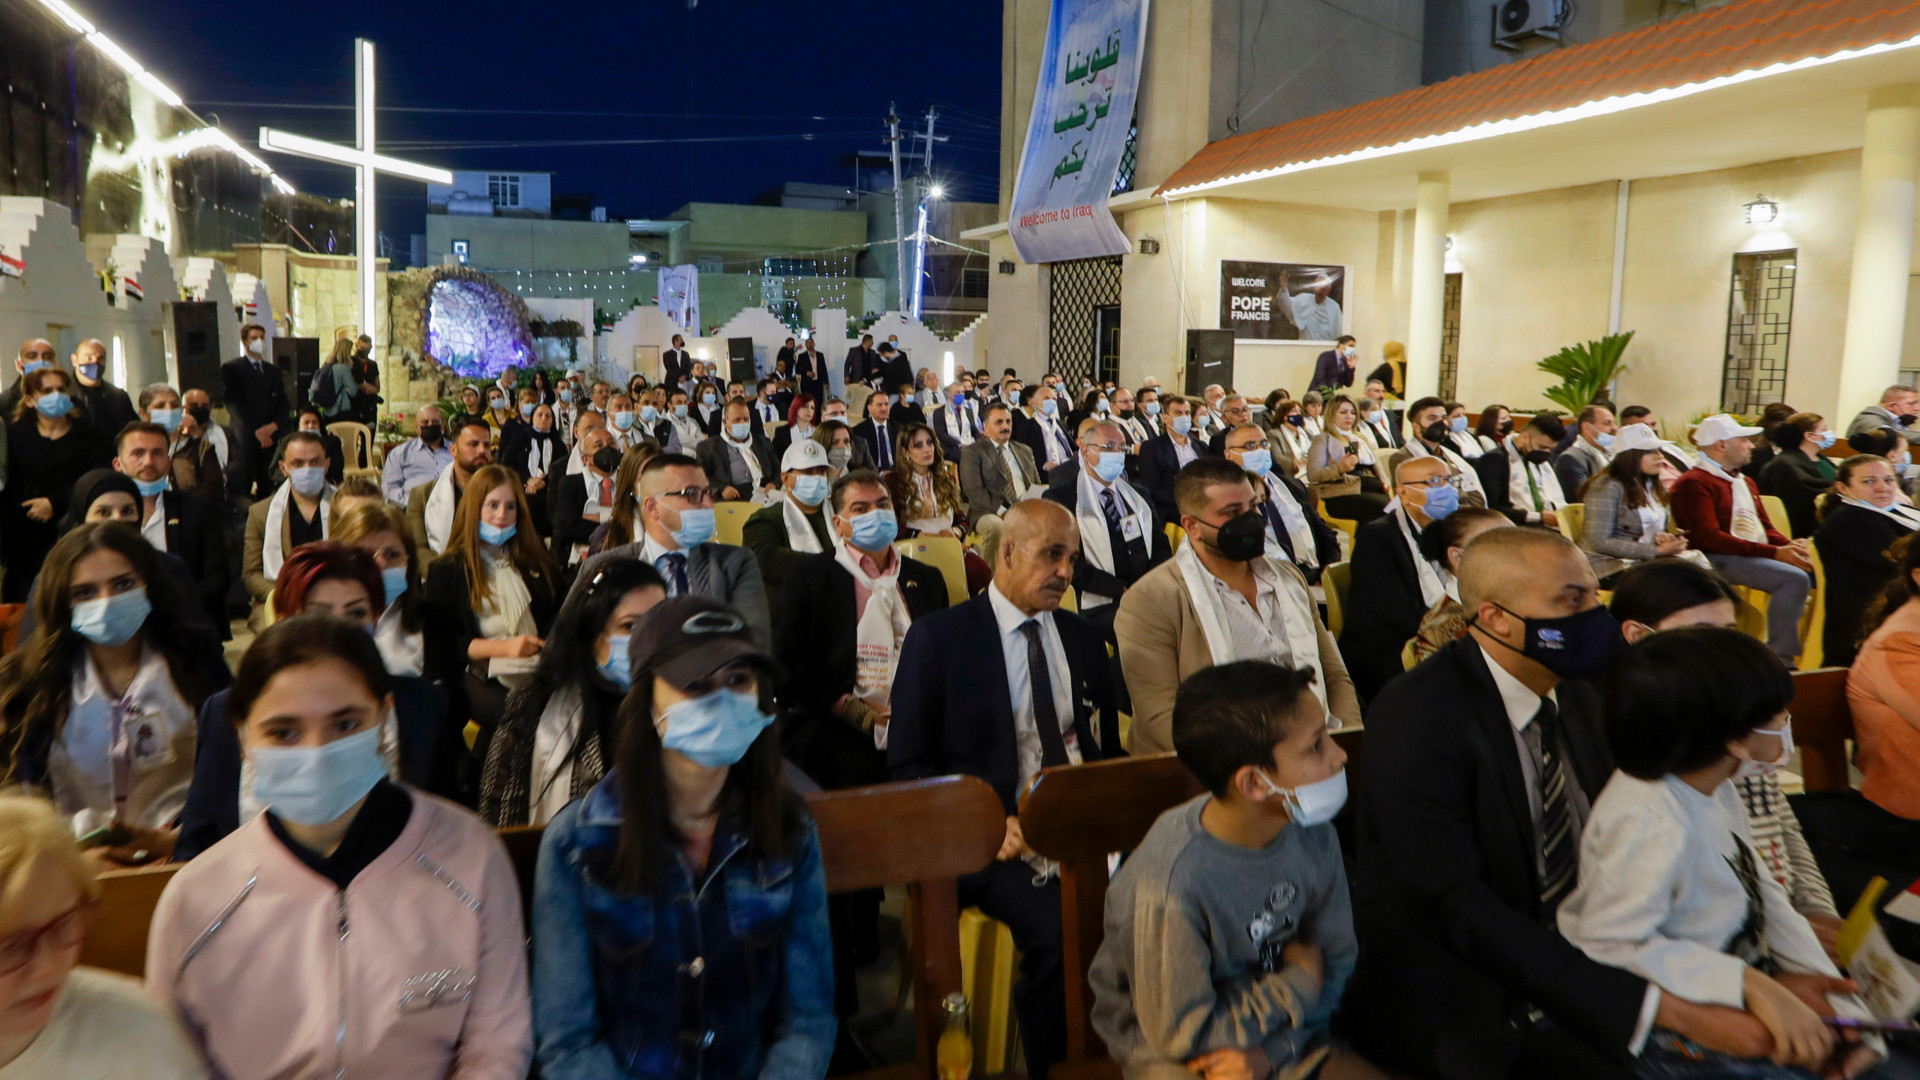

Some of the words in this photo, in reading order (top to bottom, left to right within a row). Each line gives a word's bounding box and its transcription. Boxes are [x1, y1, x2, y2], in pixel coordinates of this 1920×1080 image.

[1064, 28, 1121, 86] قلوبنا
[1054, 86, 1112, 140] ترحب
[1049, 139, 1088, 191] بكم
[1020, 211, 1058, 228] Welcome
[1060, 208, 1070, 220] to
[1072, 204, 1094, 219] Iraq
[1231, 277, 1266, 288] WELCOME
[1231, 296, 1271, 311] POPE
[1231, 311, 1271, 321] FRANCIS
